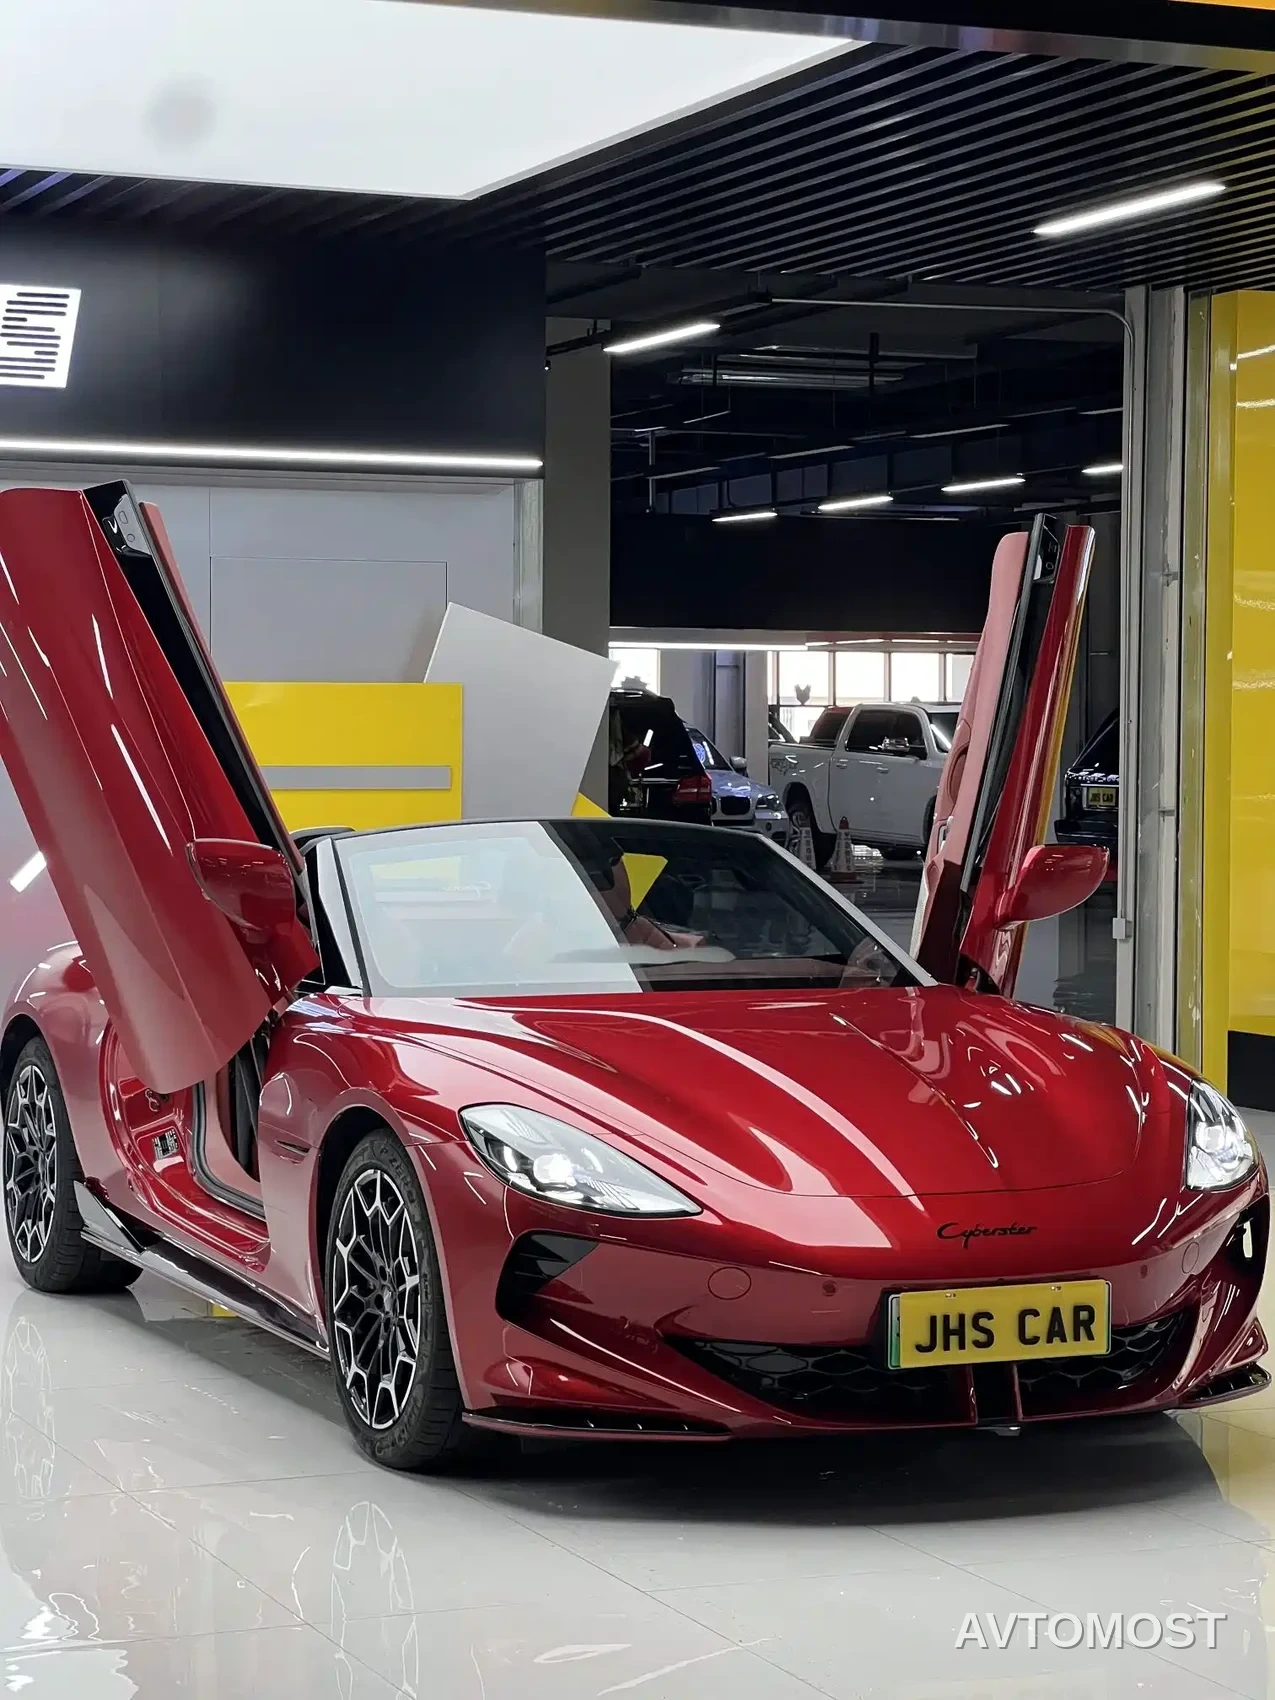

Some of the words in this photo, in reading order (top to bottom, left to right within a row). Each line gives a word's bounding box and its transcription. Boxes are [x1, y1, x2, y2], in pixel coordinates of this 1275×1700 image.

[936, 1221, 1038, 1250] Cyberster
[915, 1311, 995, 1354] JHS
[1017, 1304, 1096, 1346] CAR
